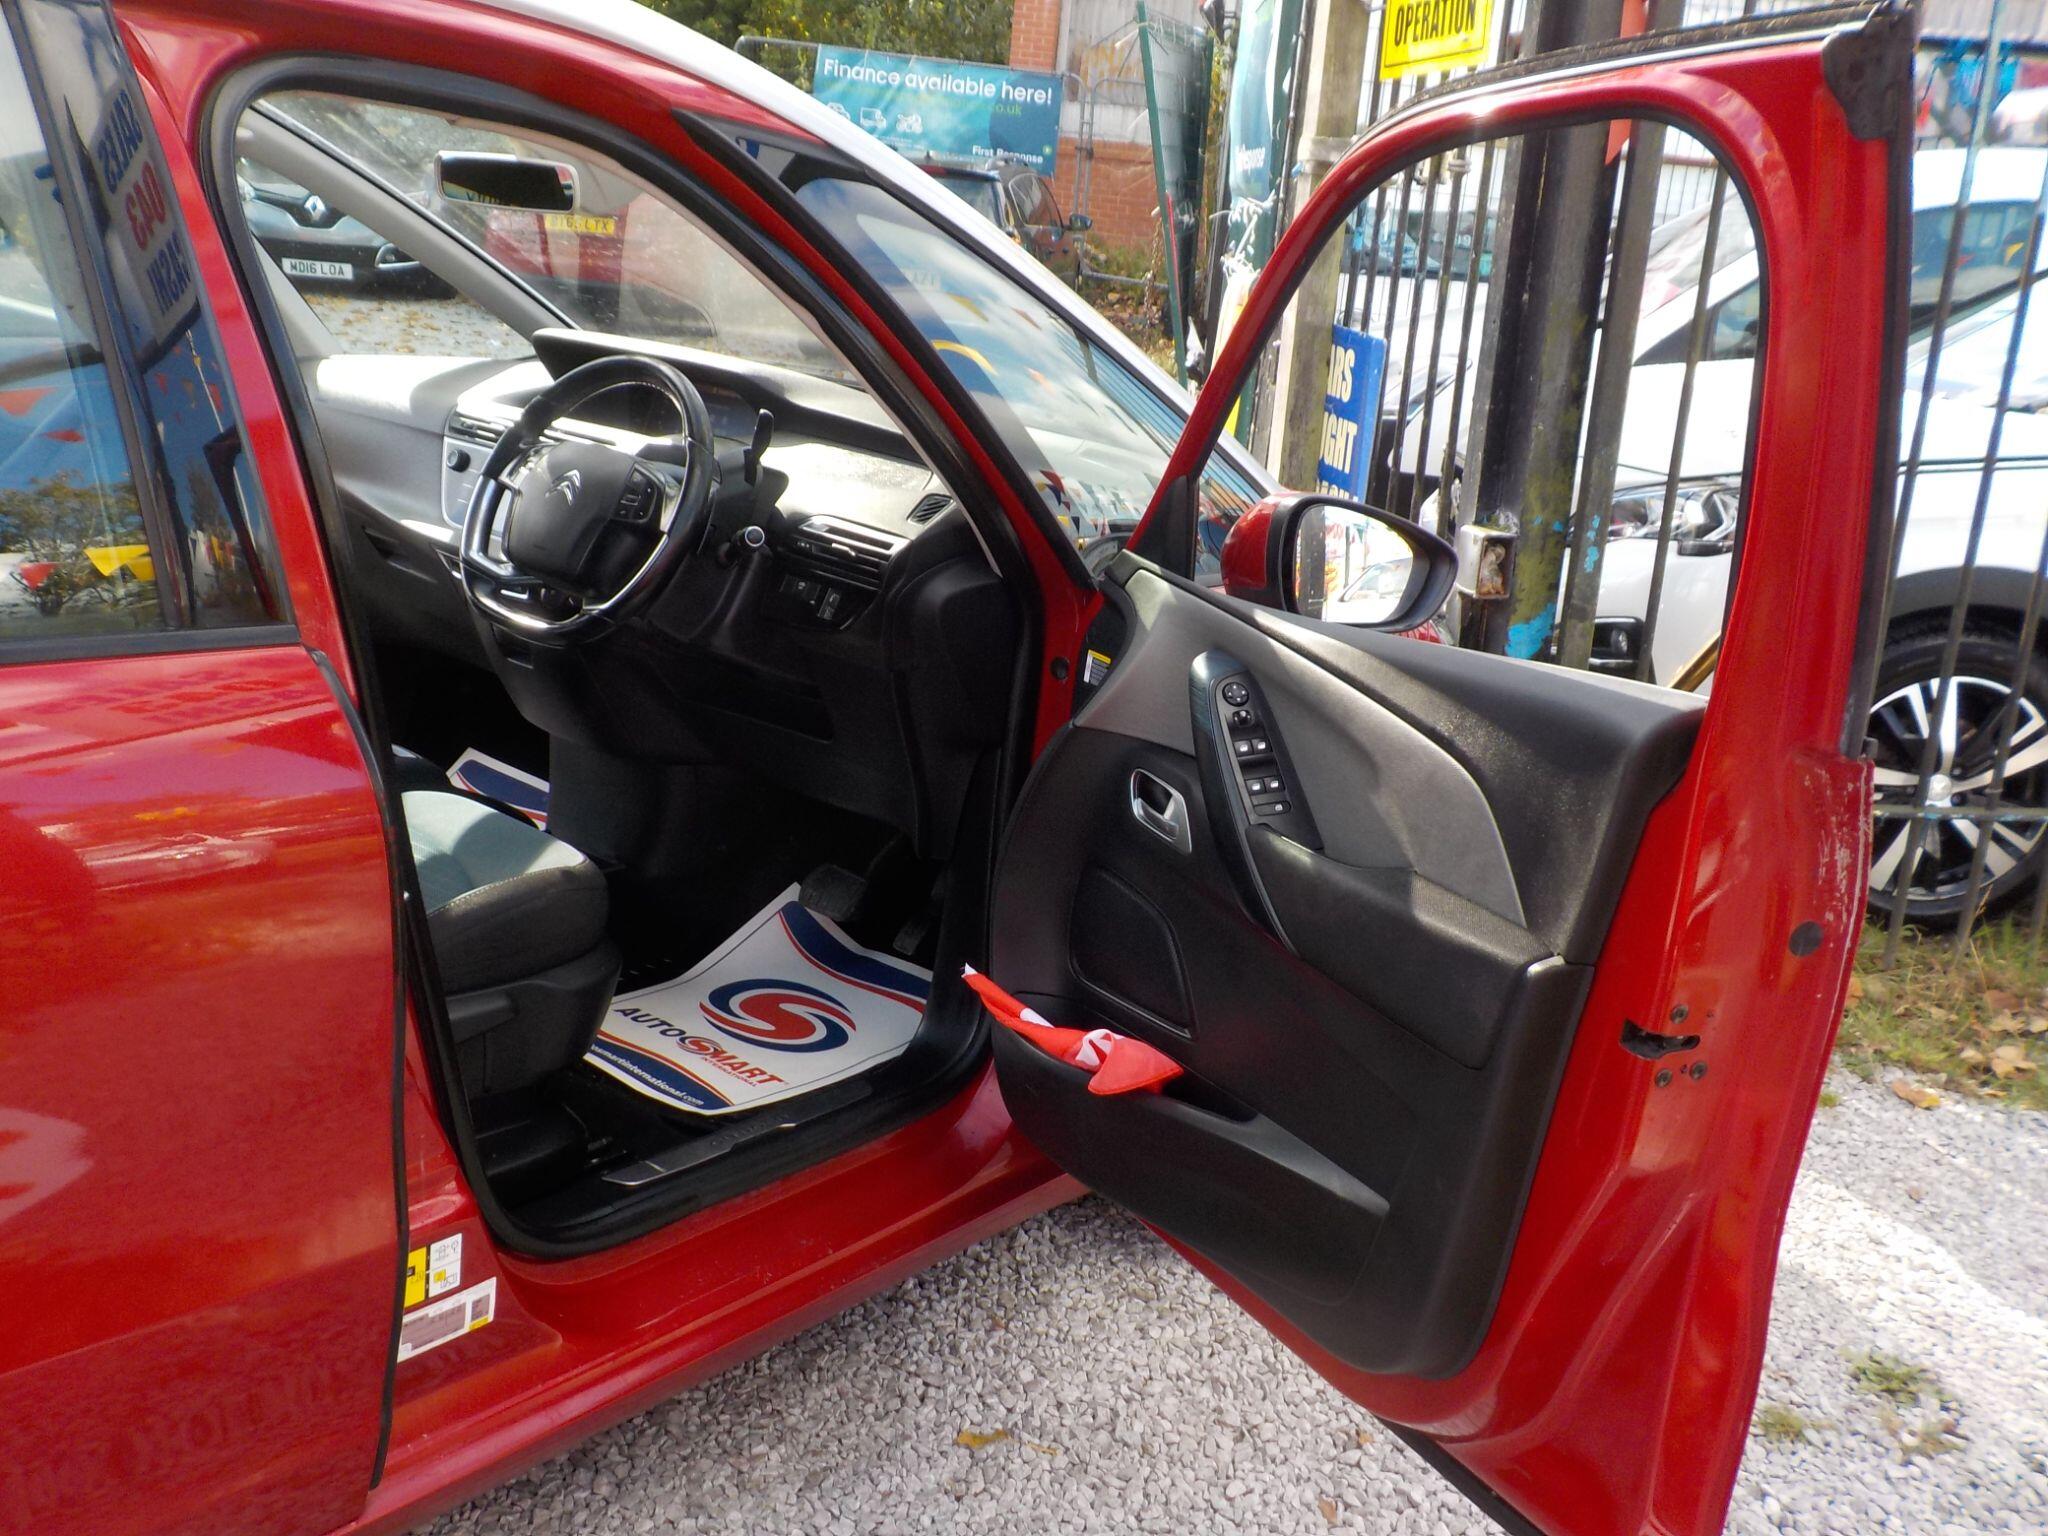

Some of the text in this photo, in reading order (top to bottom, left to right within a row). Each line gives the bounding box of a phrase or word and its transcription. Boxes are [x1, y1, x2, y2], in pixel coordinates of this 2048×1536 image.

[1394, 0, 1475, 46] OPERATION
[823, 58, 1053, 105] Finance available here!
[972, 144, 994, 157] First
[320, 263, 345, 276] LOA
